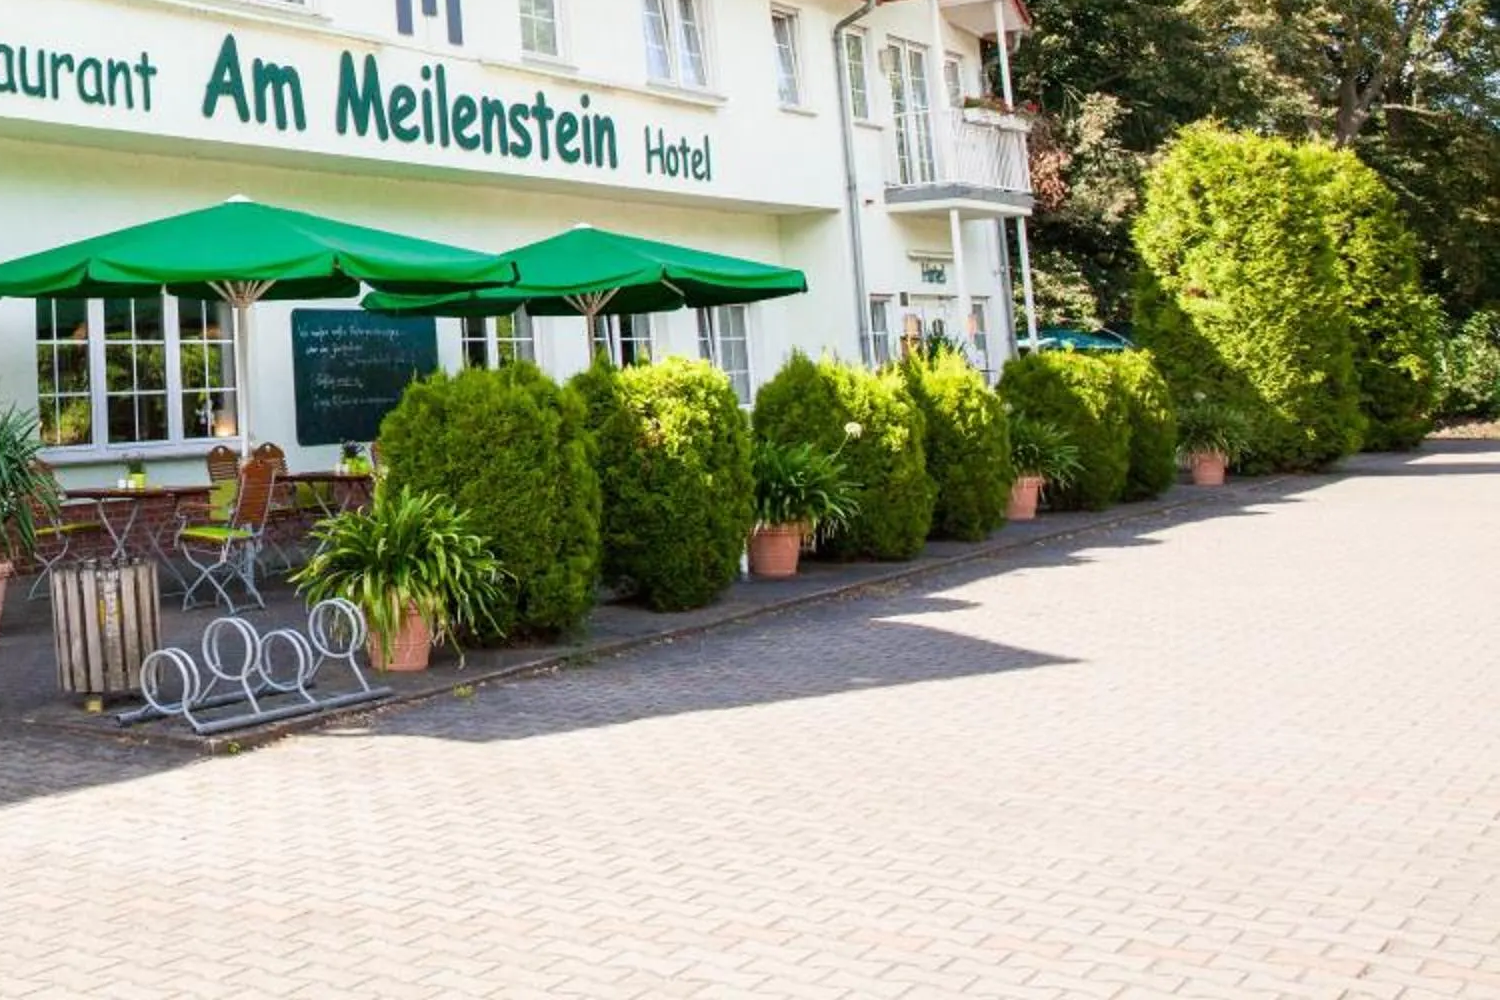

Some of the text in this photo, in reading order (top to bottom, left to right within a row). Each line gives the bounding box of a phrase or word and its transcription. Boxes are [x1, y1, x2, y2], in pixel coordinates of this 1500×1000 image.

[202, 33, 307, 132] Am
[336, 50, 618, 170] Meilenstein
[645, 126, 712, 182] Hotel
